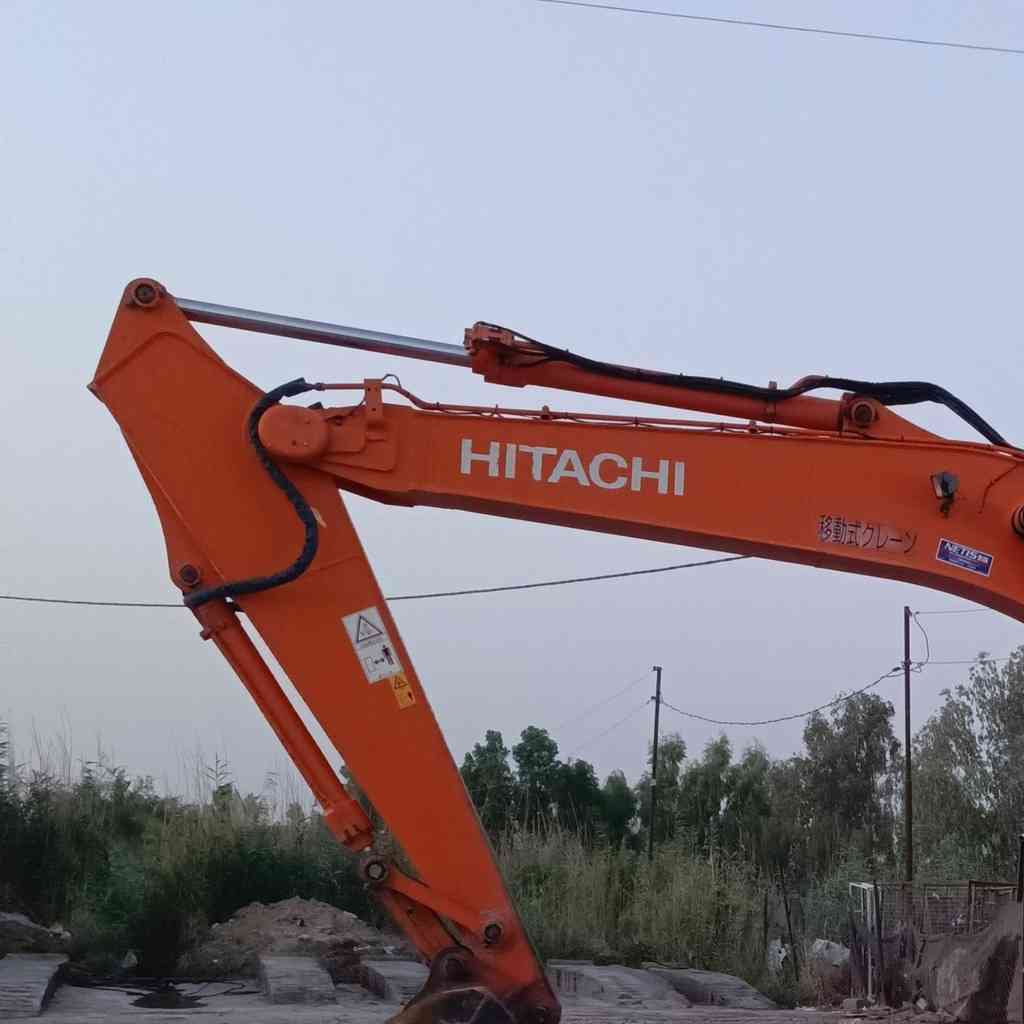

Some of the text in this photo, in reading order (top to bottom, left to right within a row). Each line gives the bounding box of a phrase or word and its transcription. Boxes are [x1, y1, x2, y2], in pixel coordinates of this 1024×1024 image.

[460, 438, 685, 496] HITACHI
[818, 514, 918, 553] 移動式クレーン
